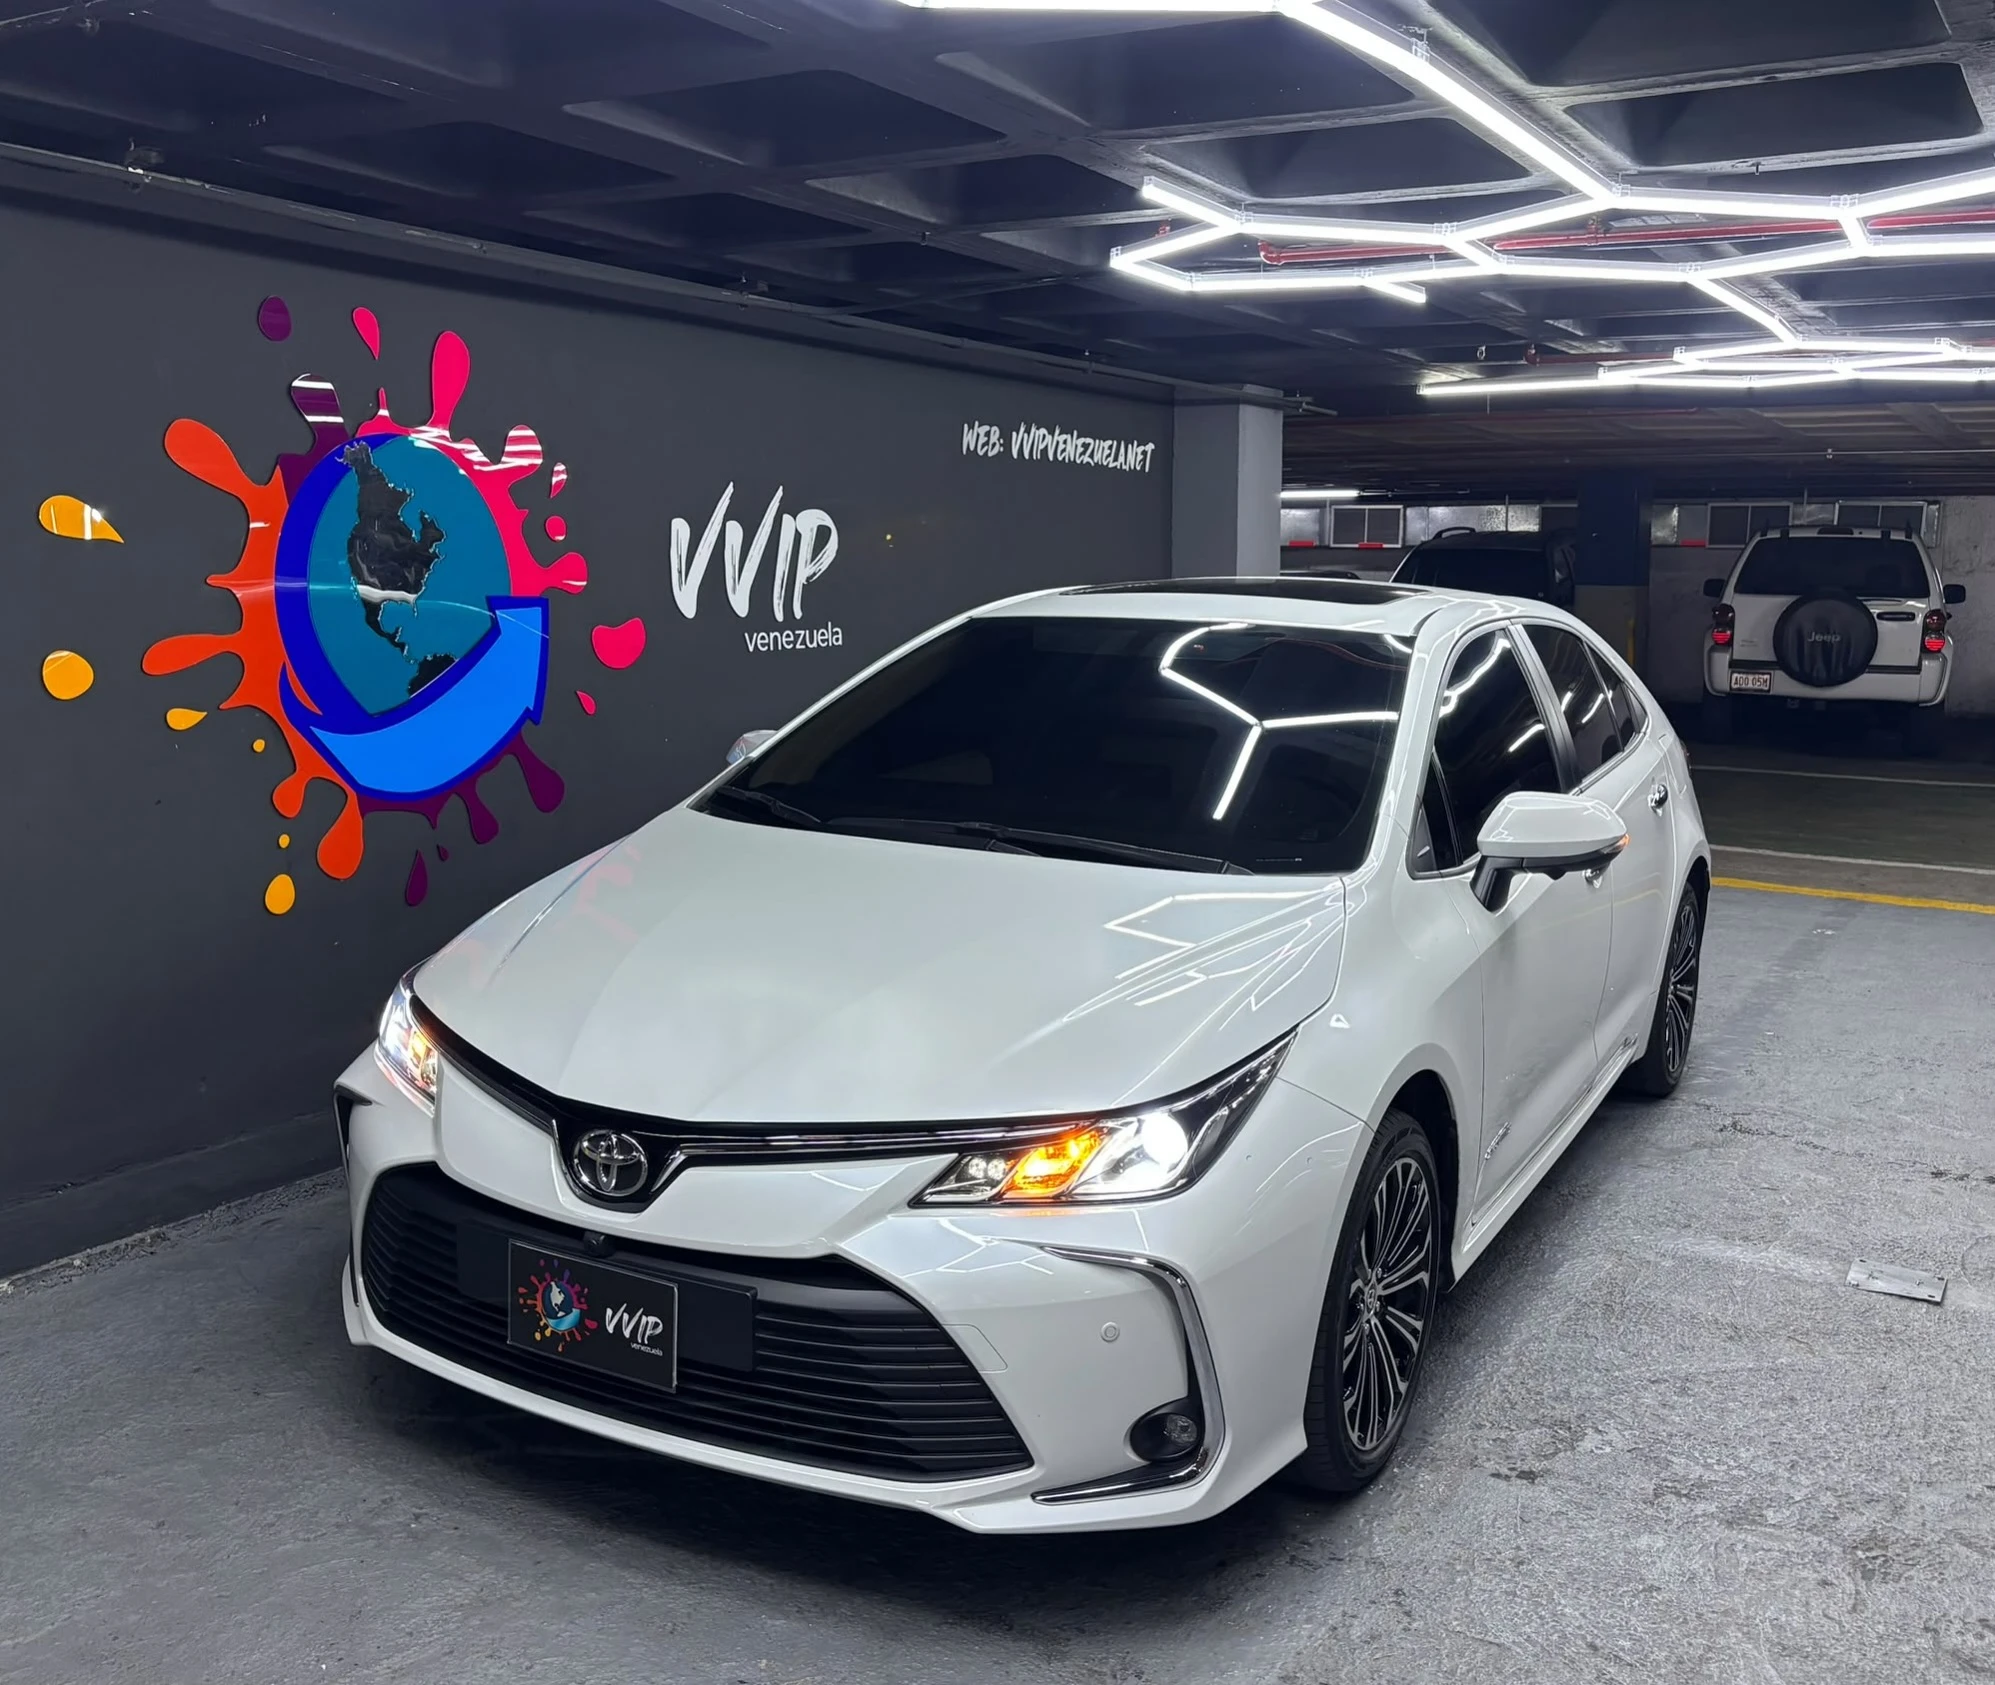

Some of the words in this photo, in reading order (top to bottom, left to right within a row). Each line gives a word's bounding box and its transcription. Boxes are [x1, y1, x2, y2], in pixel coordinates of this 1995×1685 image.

[962, 420, 1004, 457] WEB:
[670, 481, 839, 622] VVIP
[744, 621, 843, 653] venezuela
[1807, 631, 1840, 643] Jeep
[606, 1303, 663, 1344] VVIP
[631, 1342, 663, 1356] venezuela
